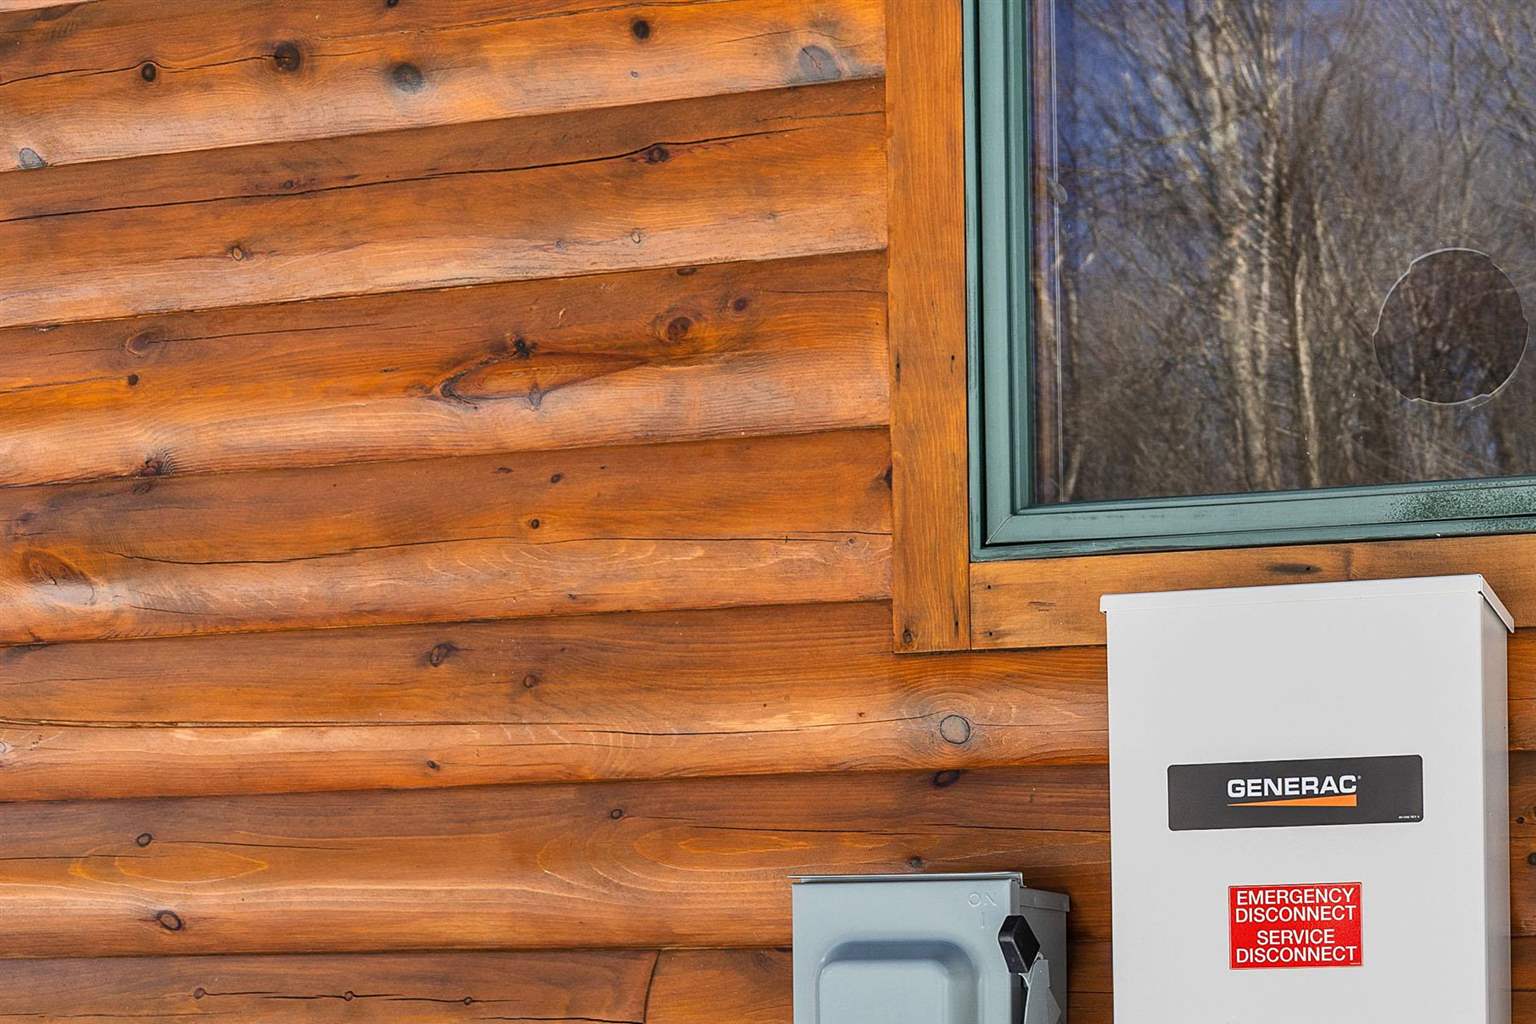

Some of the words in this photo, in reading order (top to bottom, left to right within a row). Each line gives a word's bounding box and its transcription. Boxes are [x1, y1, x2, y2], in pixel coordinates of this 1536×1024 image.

[1227, 775, 1357, 798] GENERAC
[1237, 888, 1354, 906] EMERGENCY
[1236, 904, 1356, 924] DISCONNECT
[1256, 928, 1335, 946] SERVICE
[1236, 946, 1357, 964] DISCONNECT
